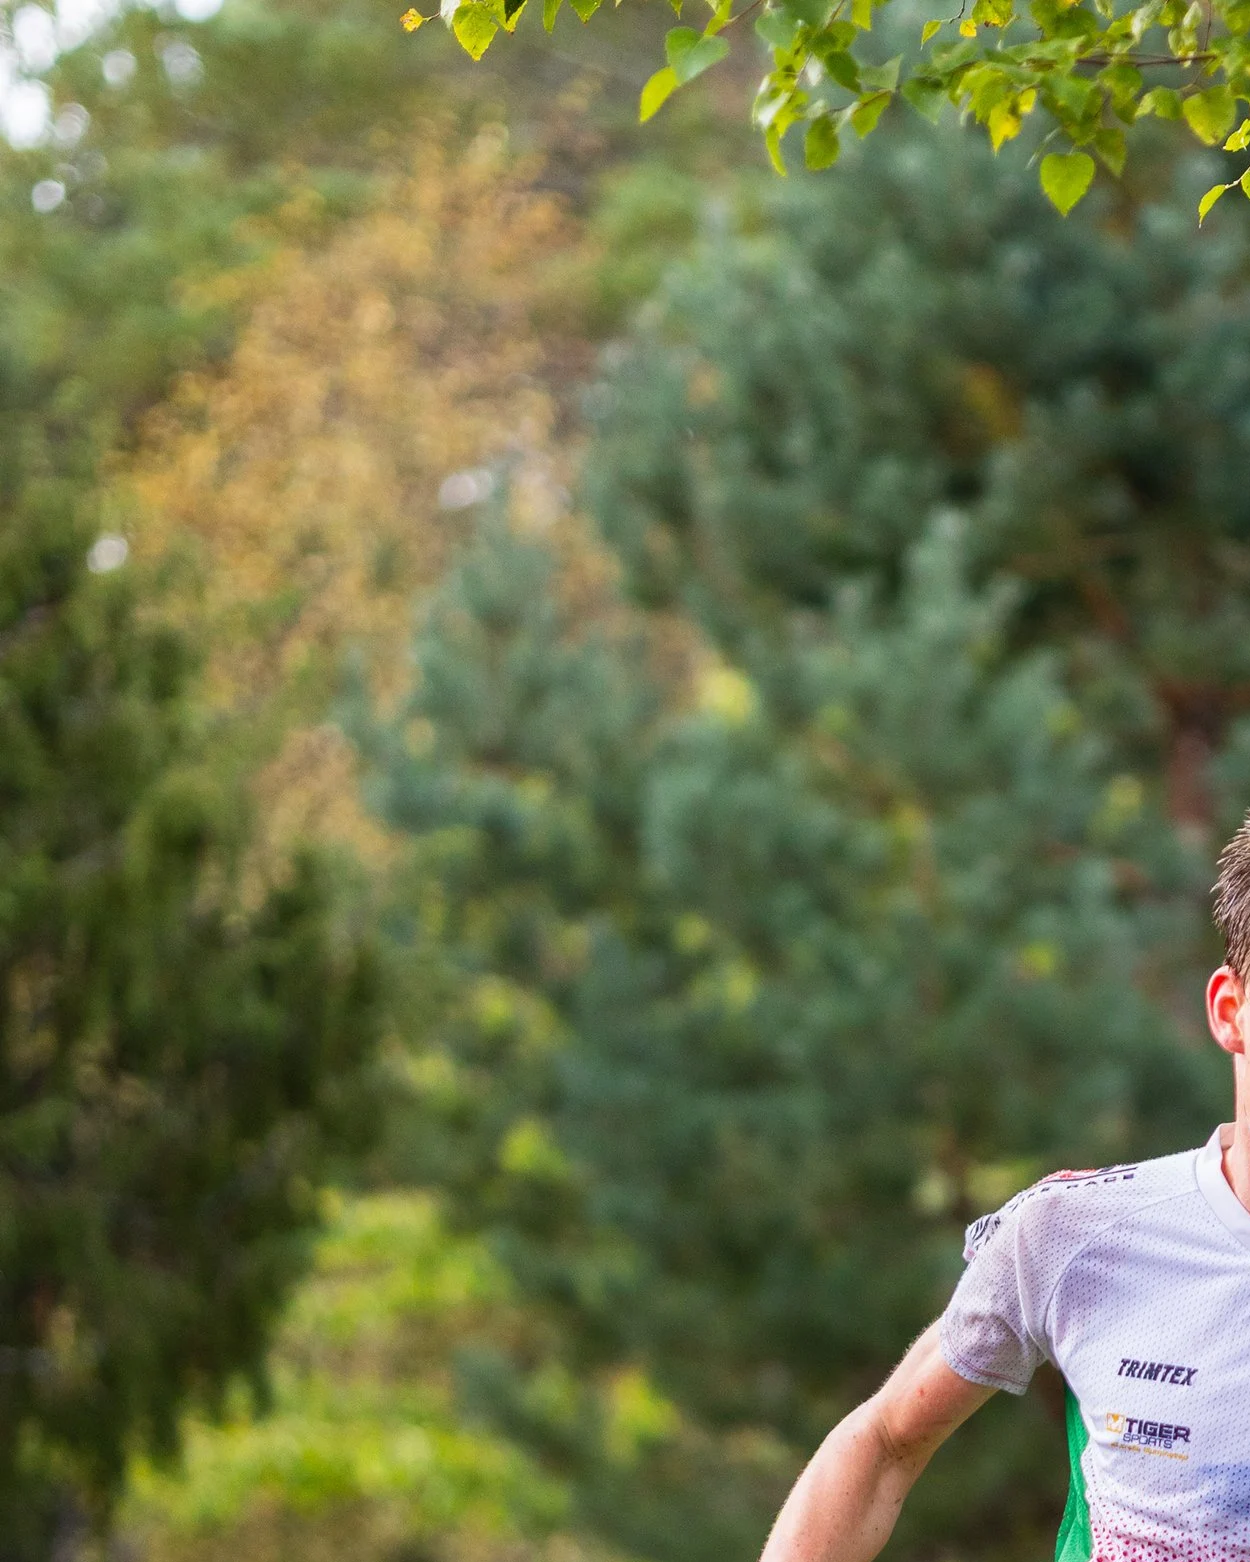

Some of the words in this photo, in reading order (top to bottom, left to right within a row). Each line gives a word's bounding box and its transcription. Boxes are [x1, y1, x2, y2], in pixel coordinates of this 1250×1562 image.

[1117, 1358, 1198, 1387] TRIMTEX
[1123, 1433, 1173, 1449] SPORTS
[1126, 1417, 1191, 1443] TIGER
